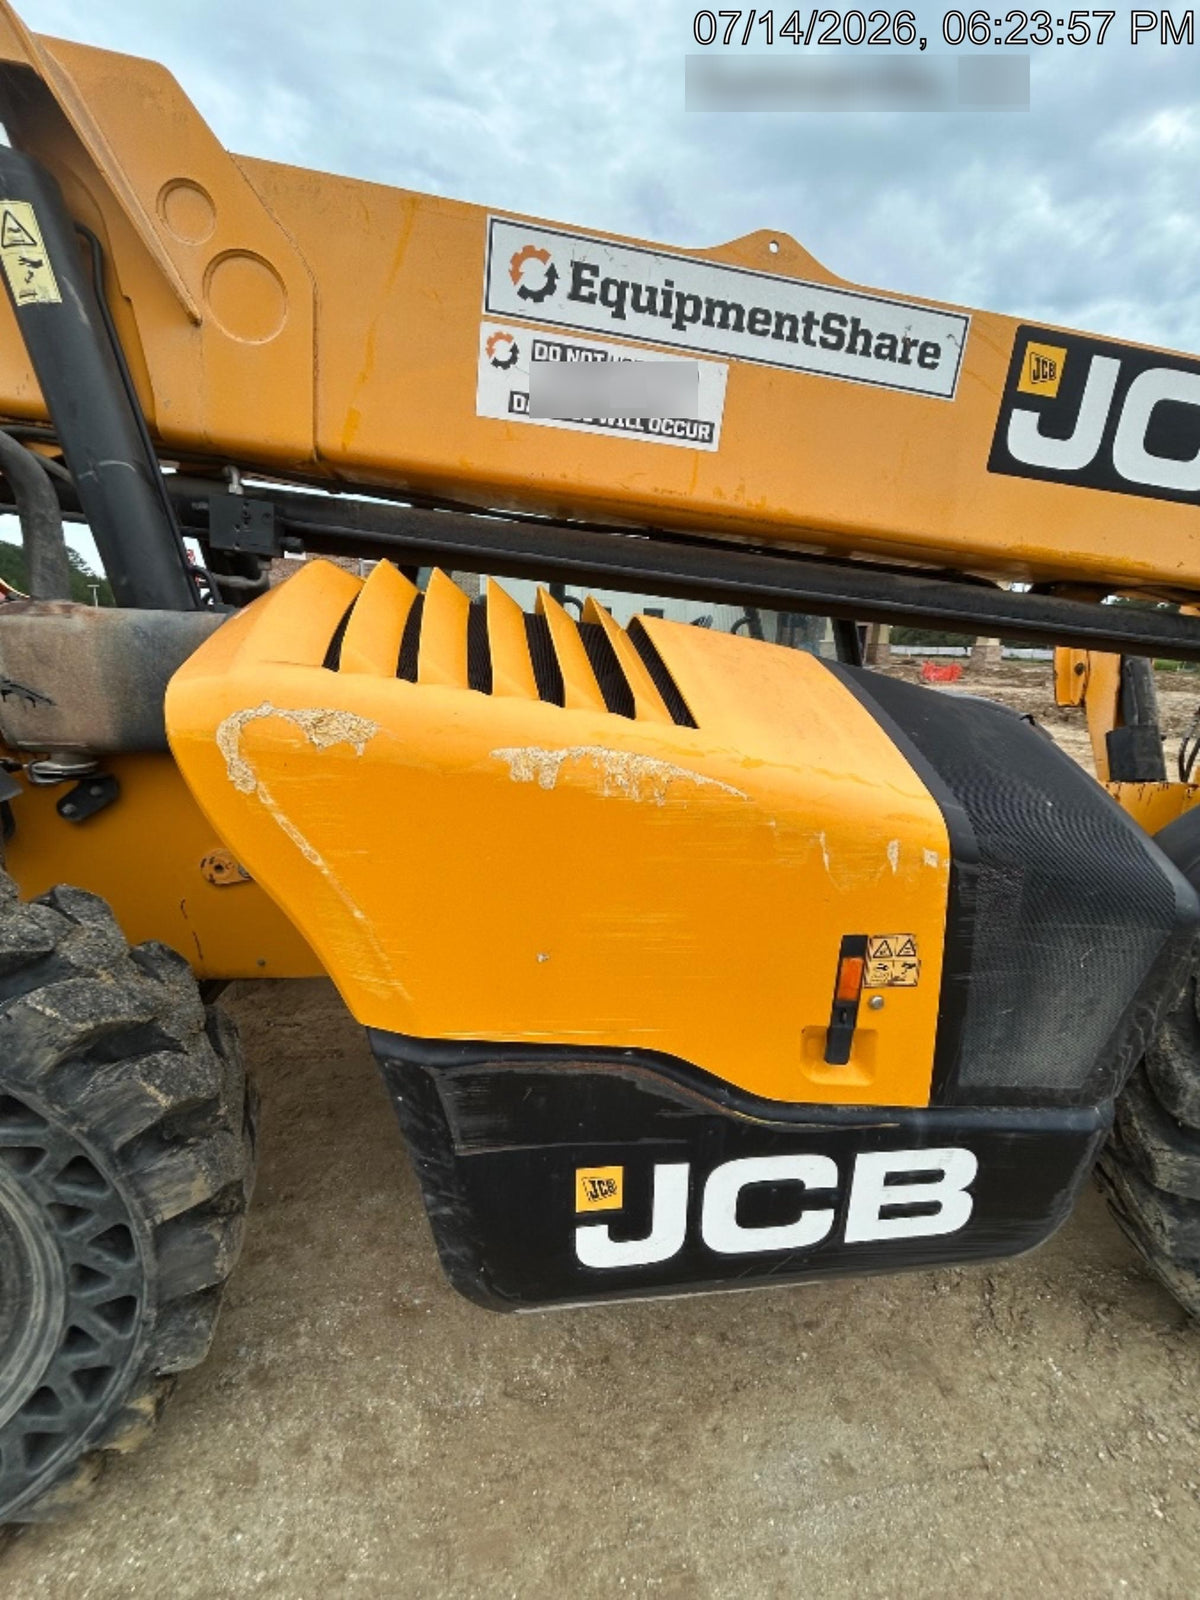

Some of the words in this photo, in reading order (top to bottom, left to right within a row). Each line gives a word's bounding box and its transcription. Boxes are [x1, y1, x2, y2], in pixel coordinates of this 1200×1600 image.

[567, 260, 942, 370] EquipmentShare
[534, 342, 561, 361] DO
[1031, 355, 1057, 382] JCB
[648, 418, 710, 440] OCCUR
[588, 1179, 617, 1199] JCB
[575, 1147, 979, 1268] JCB
